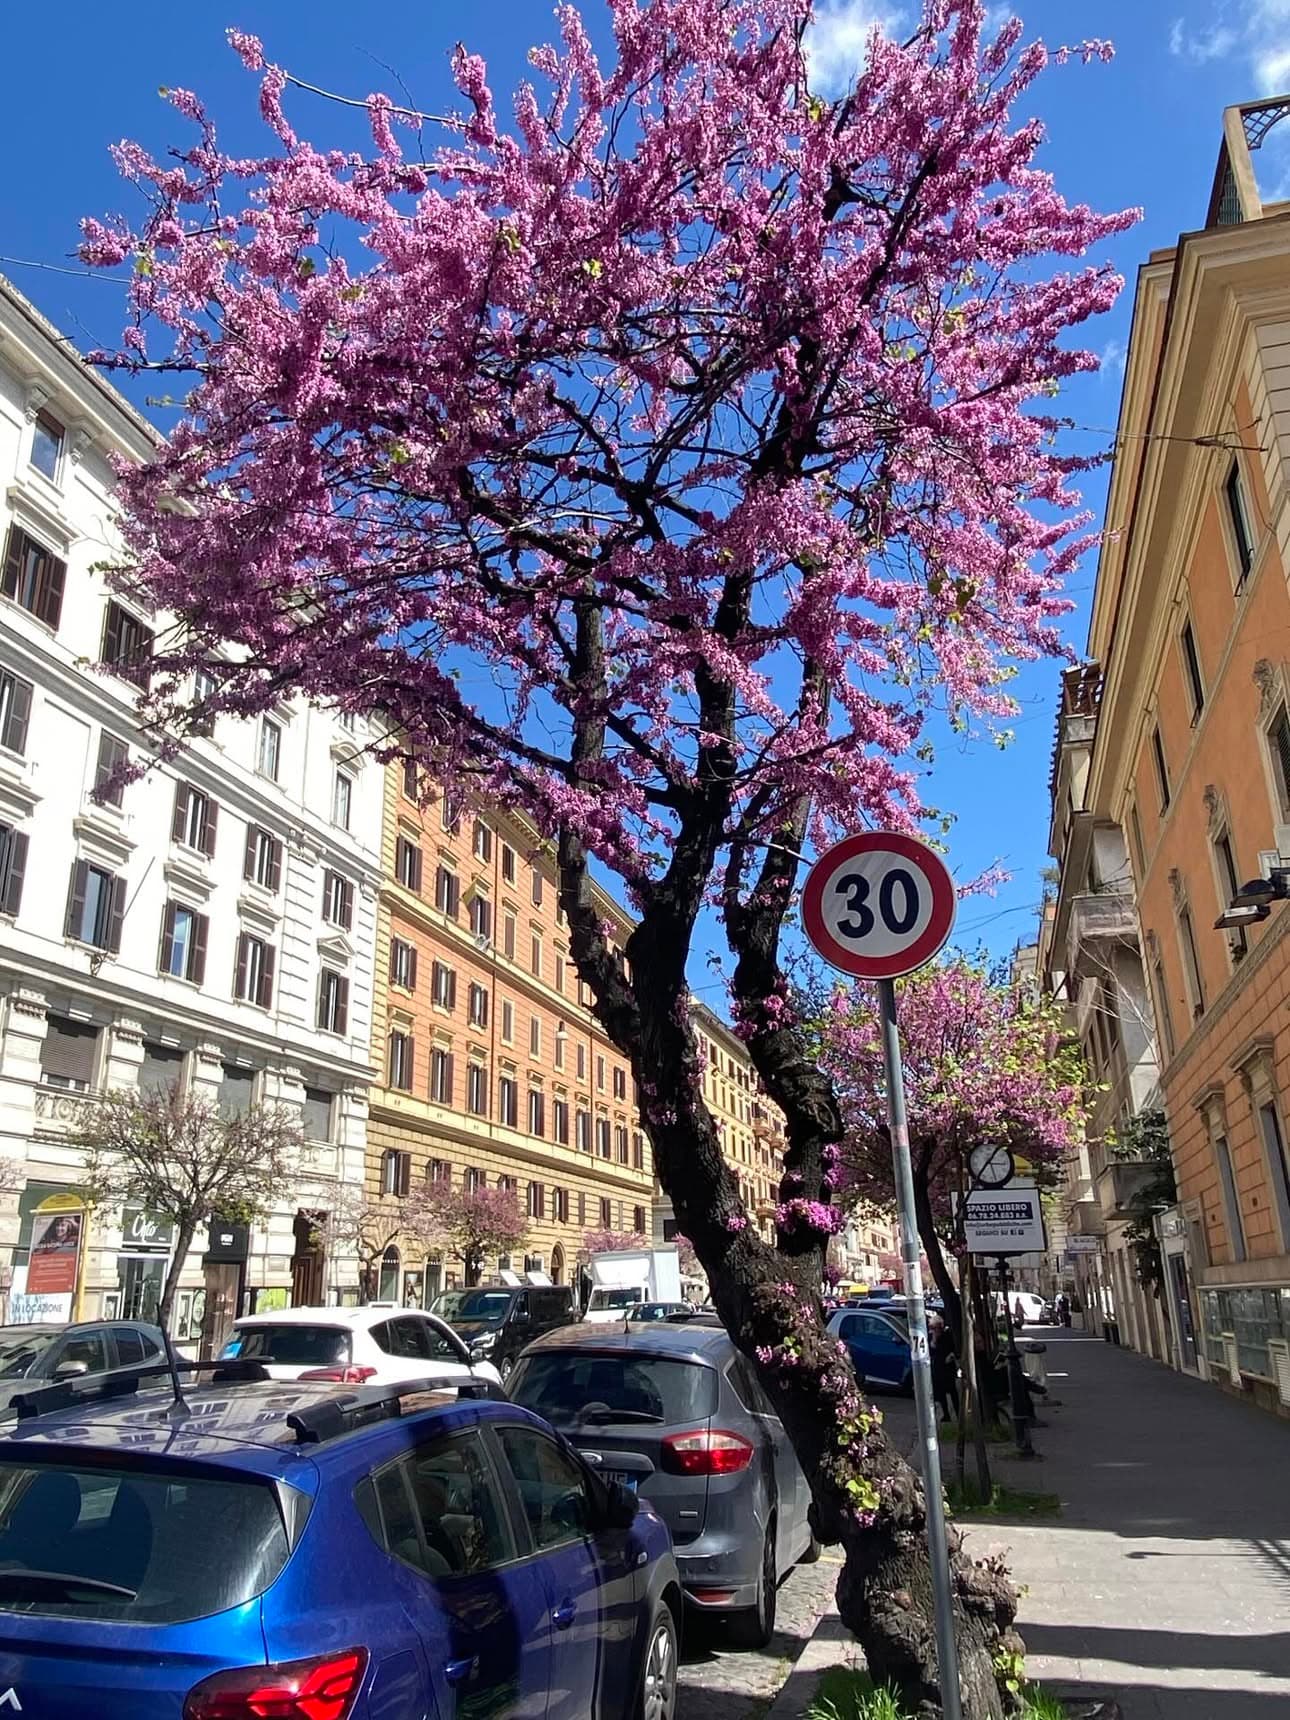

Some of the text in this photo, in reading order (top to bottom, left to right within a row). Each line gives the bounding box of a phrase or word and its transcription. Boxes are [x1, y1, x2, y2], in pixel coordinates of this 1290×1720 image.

[835, 868, 920, 939] 30
[966, 1203, 1028, 1212] SPAZIO LIBERO
[22, 1303, 64, 1313] LOCAZIONE
[912, 1335, 926, 1354] 74
